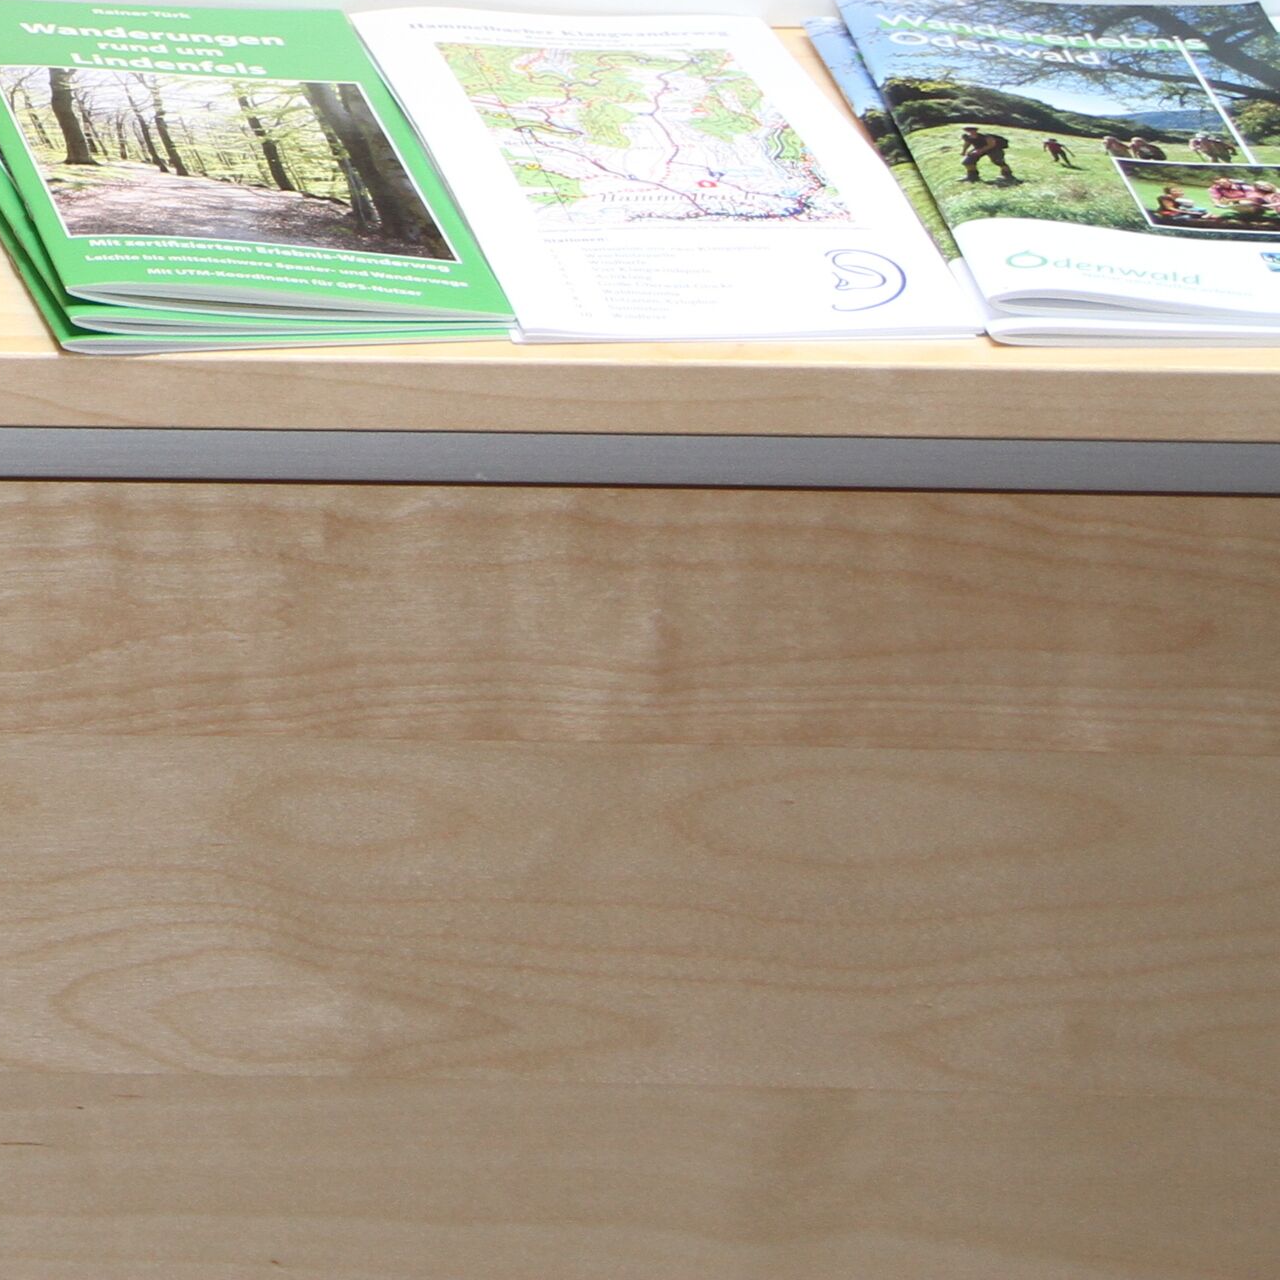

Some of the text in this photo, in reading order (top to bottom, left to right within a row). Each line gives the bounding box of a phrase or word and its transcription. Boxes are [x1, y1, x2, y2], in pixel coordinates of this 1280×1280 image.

[91, 8, 191, 19] Rainer Türk
[19, 22, 285, 47] Wanderungen
[876, 14, 1205, 49] Wandererlebnis
[70, 53, 268, 75] Lindenfels
[97, 42, 224, 57] rund um
[889, 32, 1102, 65] Odenwald
[85, 254, 140, 262] Leichte
[168, 255, 273, 268] mittelschwere
[339, 268, 369, 276] und
[367, 269, 469, 288] Wanderwege
[88, 239, 451, 273] Mit zertifiziertem Erlebnis-Wanderweg
[1005, 250, 1201, 286] Odenwald
[146, 267, 422, 297] Mit UTM-Koordinaten für GPS-Nutzer
